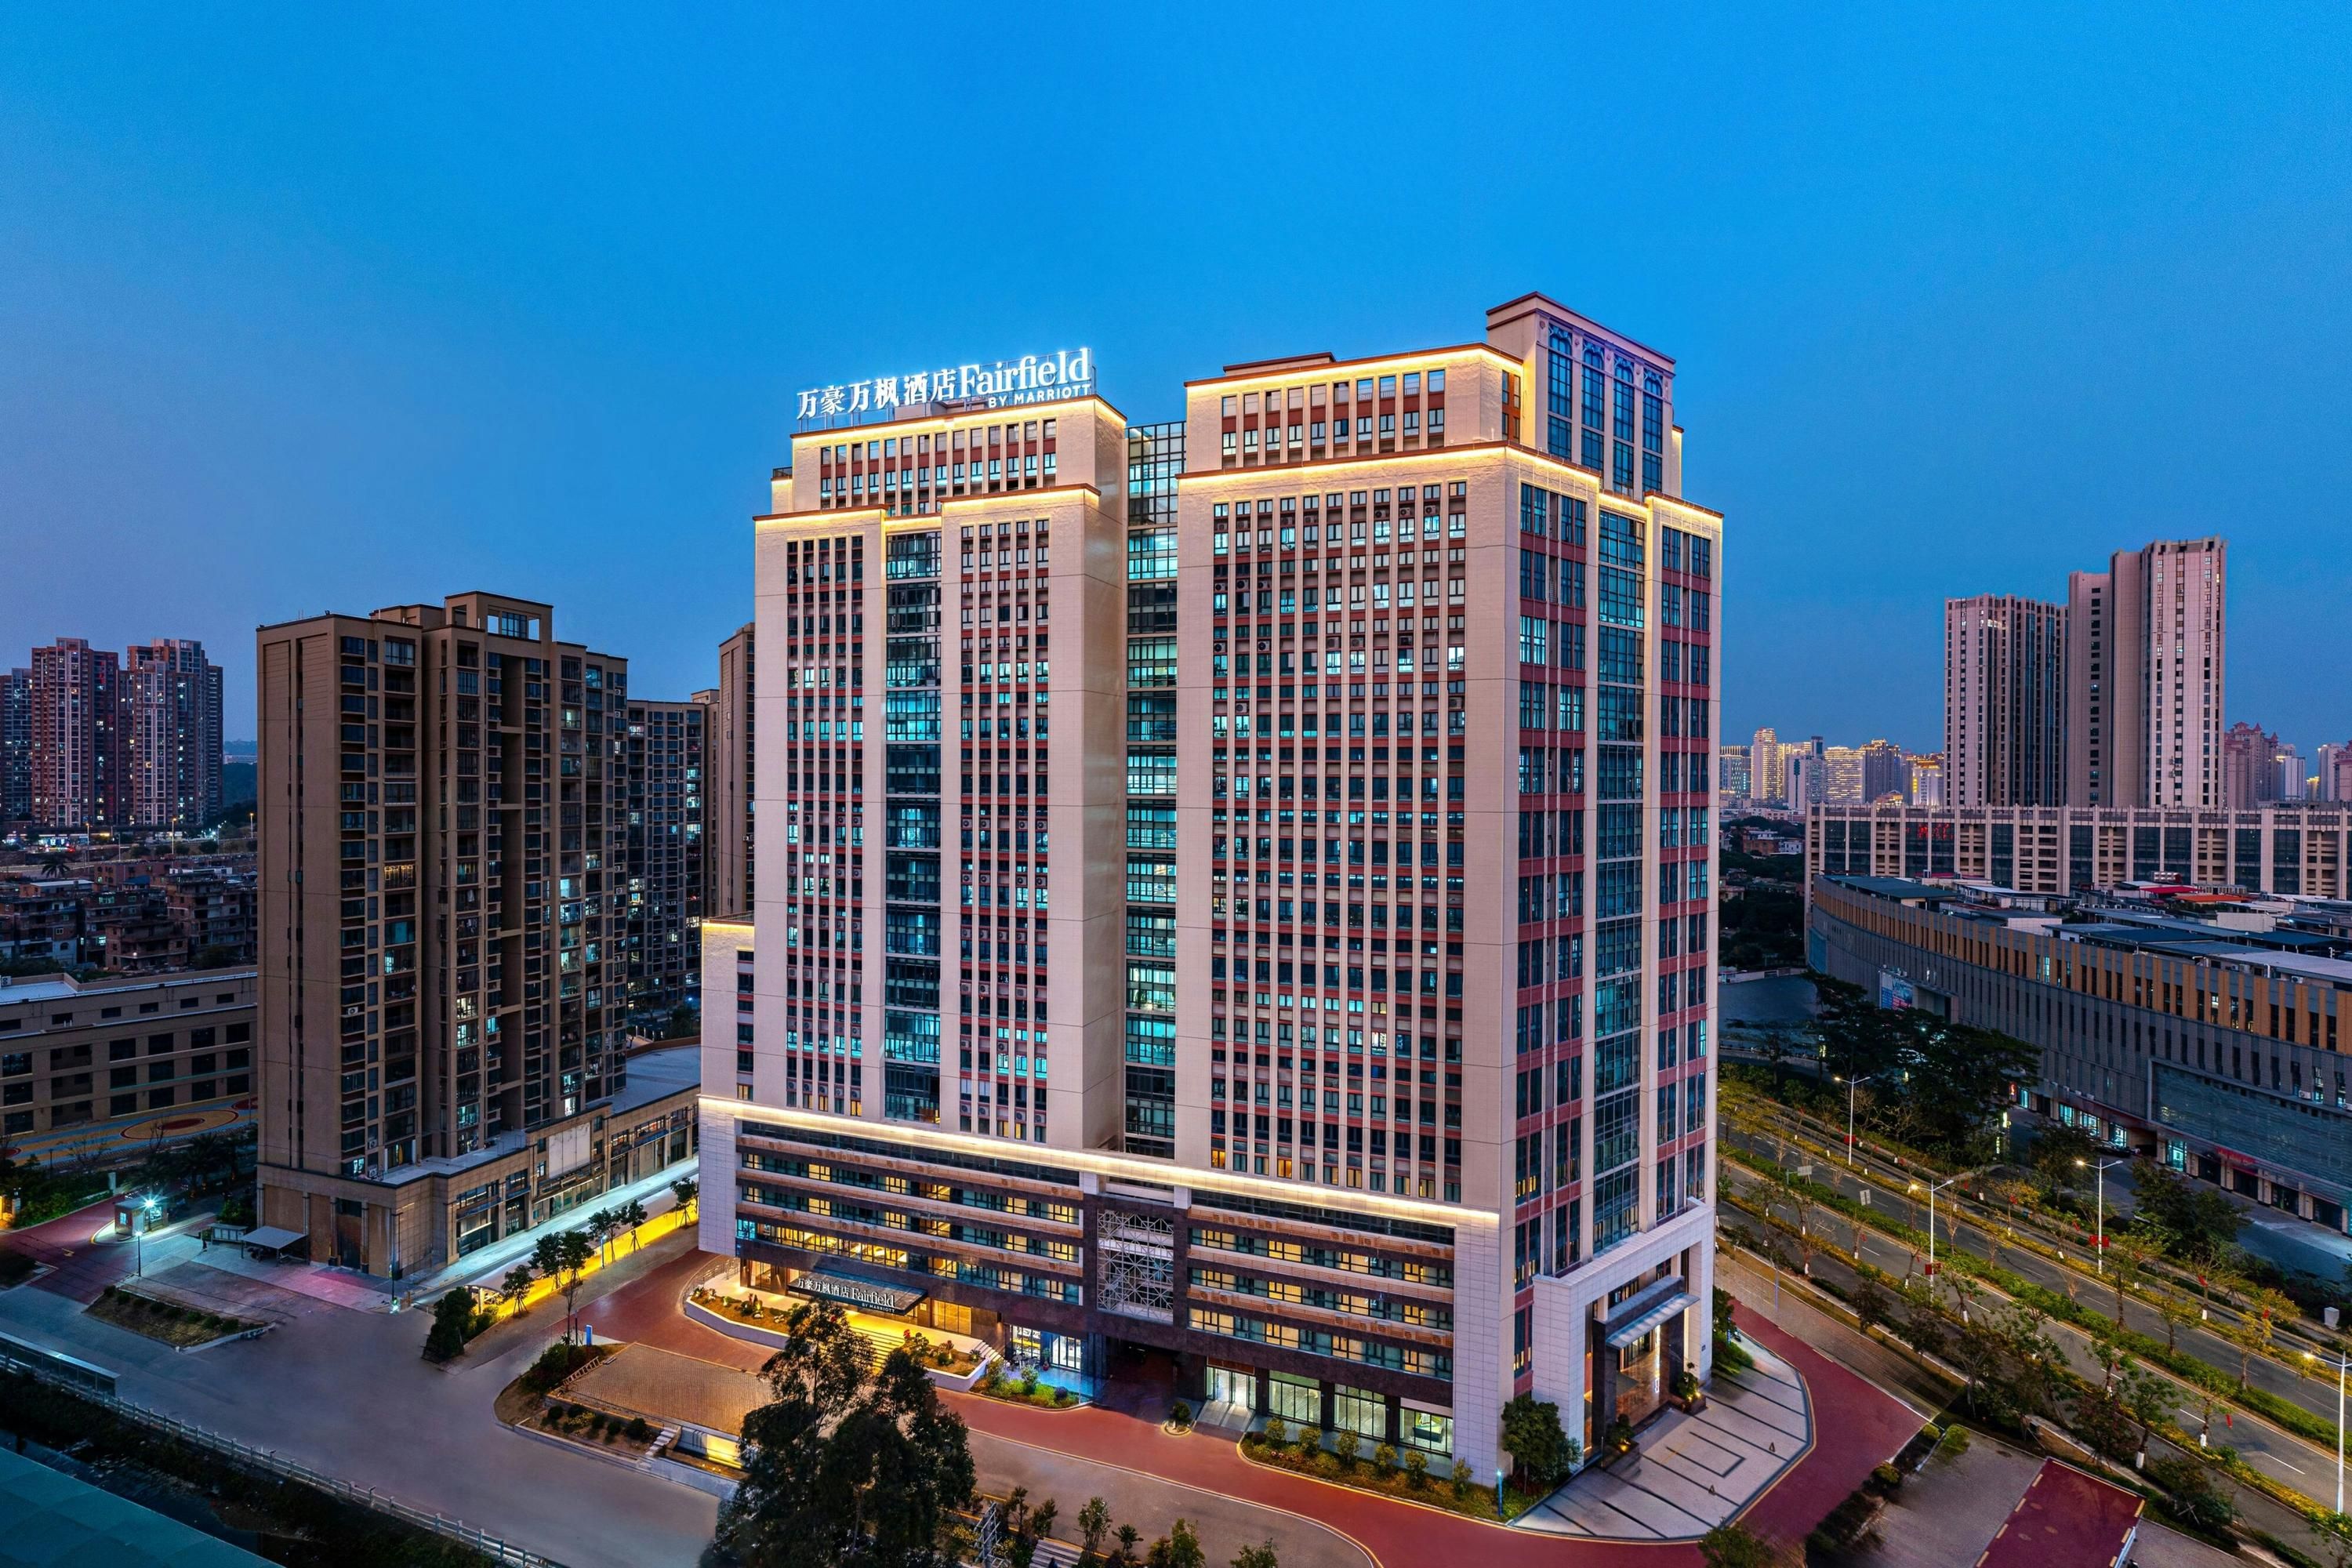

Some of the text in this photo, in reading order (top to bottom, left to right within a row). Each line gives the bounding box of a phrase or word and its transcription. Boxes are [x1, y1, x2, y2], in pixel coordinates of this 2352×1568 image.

[797, 347, 1091, 419] 万豪万枫酒店 Fairfield
[989, 383, 1091, 408] BY MARRIOTT
[852, 1287, 895, 1308] Fairfield
[870, 1304, 895, 1313] MARRIOTT
